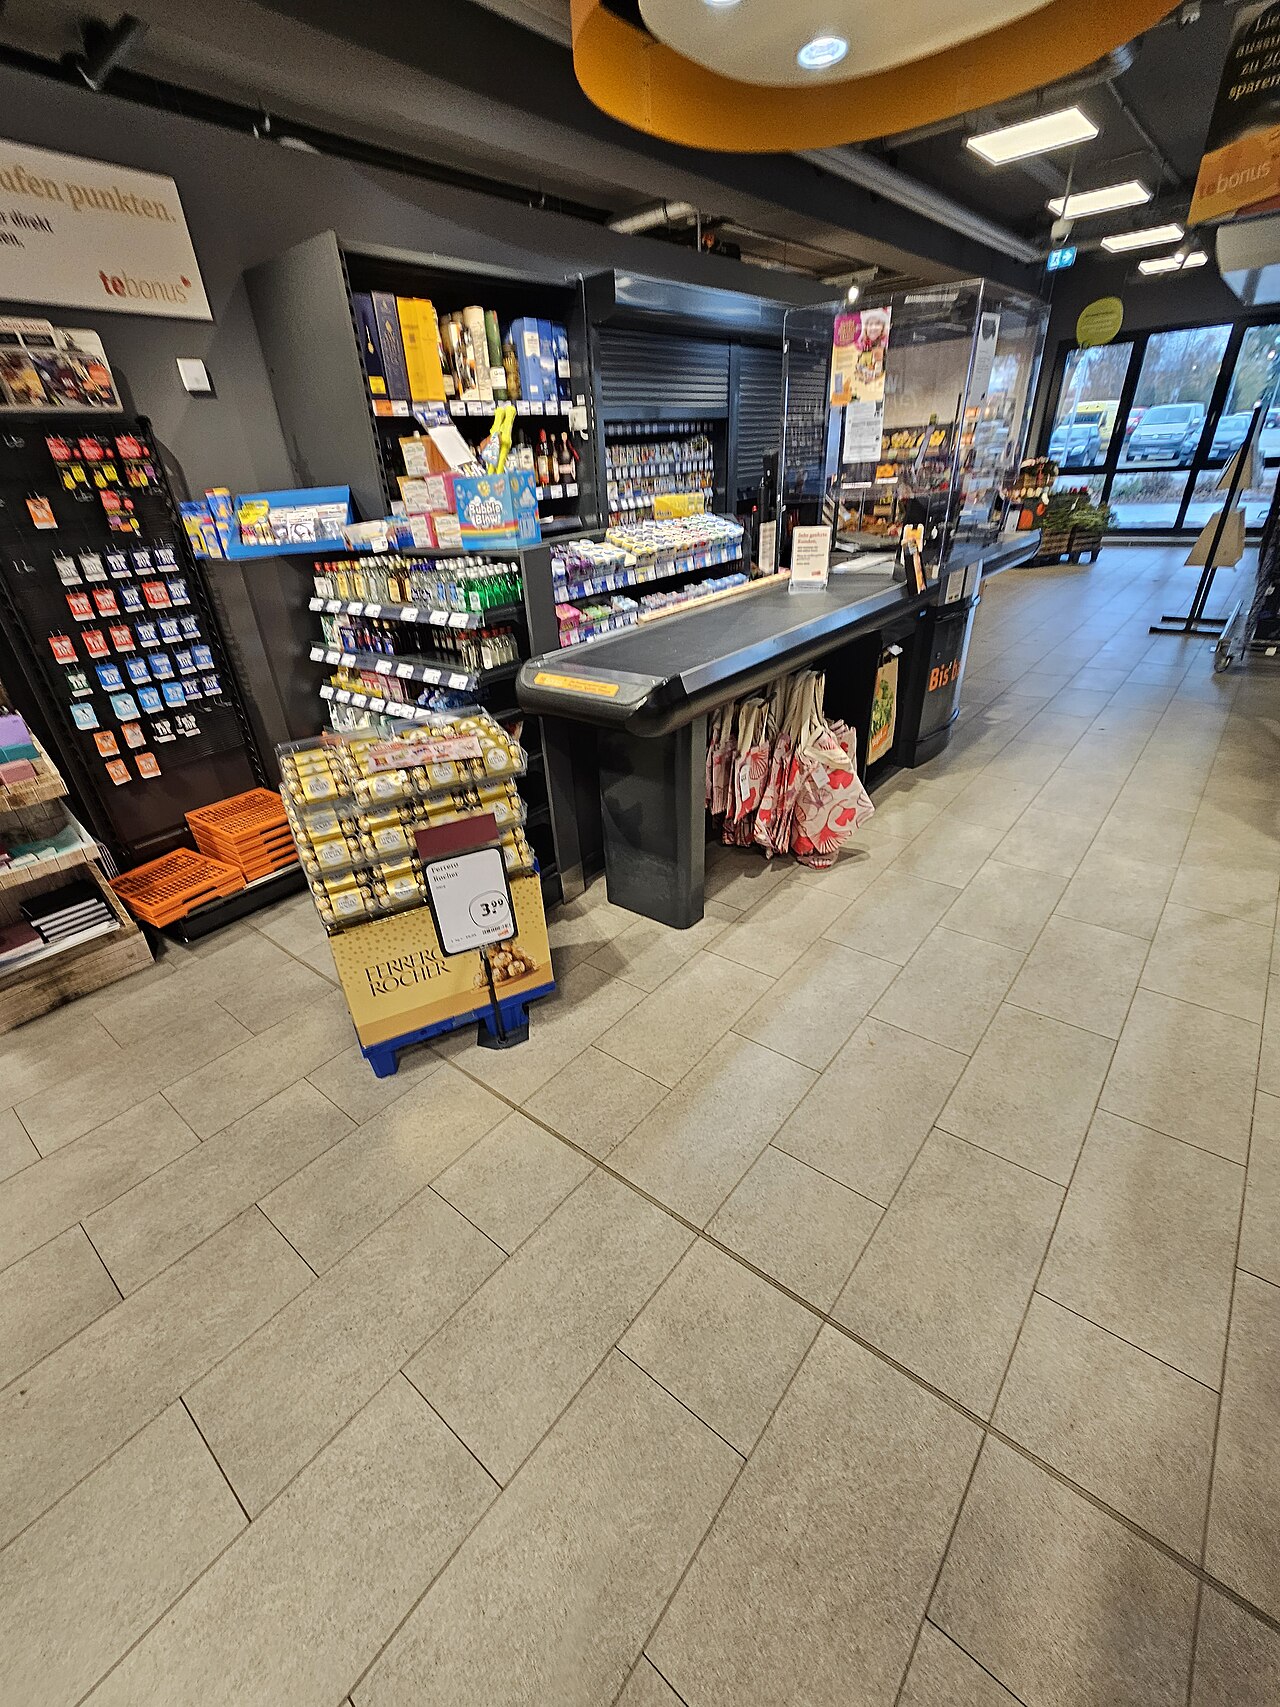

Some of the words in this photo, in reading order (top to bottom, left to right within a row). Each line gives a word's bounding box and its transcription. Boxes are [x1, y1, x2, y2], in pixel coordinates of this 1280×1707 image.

[66, 184, 176, 223] punkten.
[99, 268, 188, 304] tebonus
[369, 959, 452, 997] ROCHER
